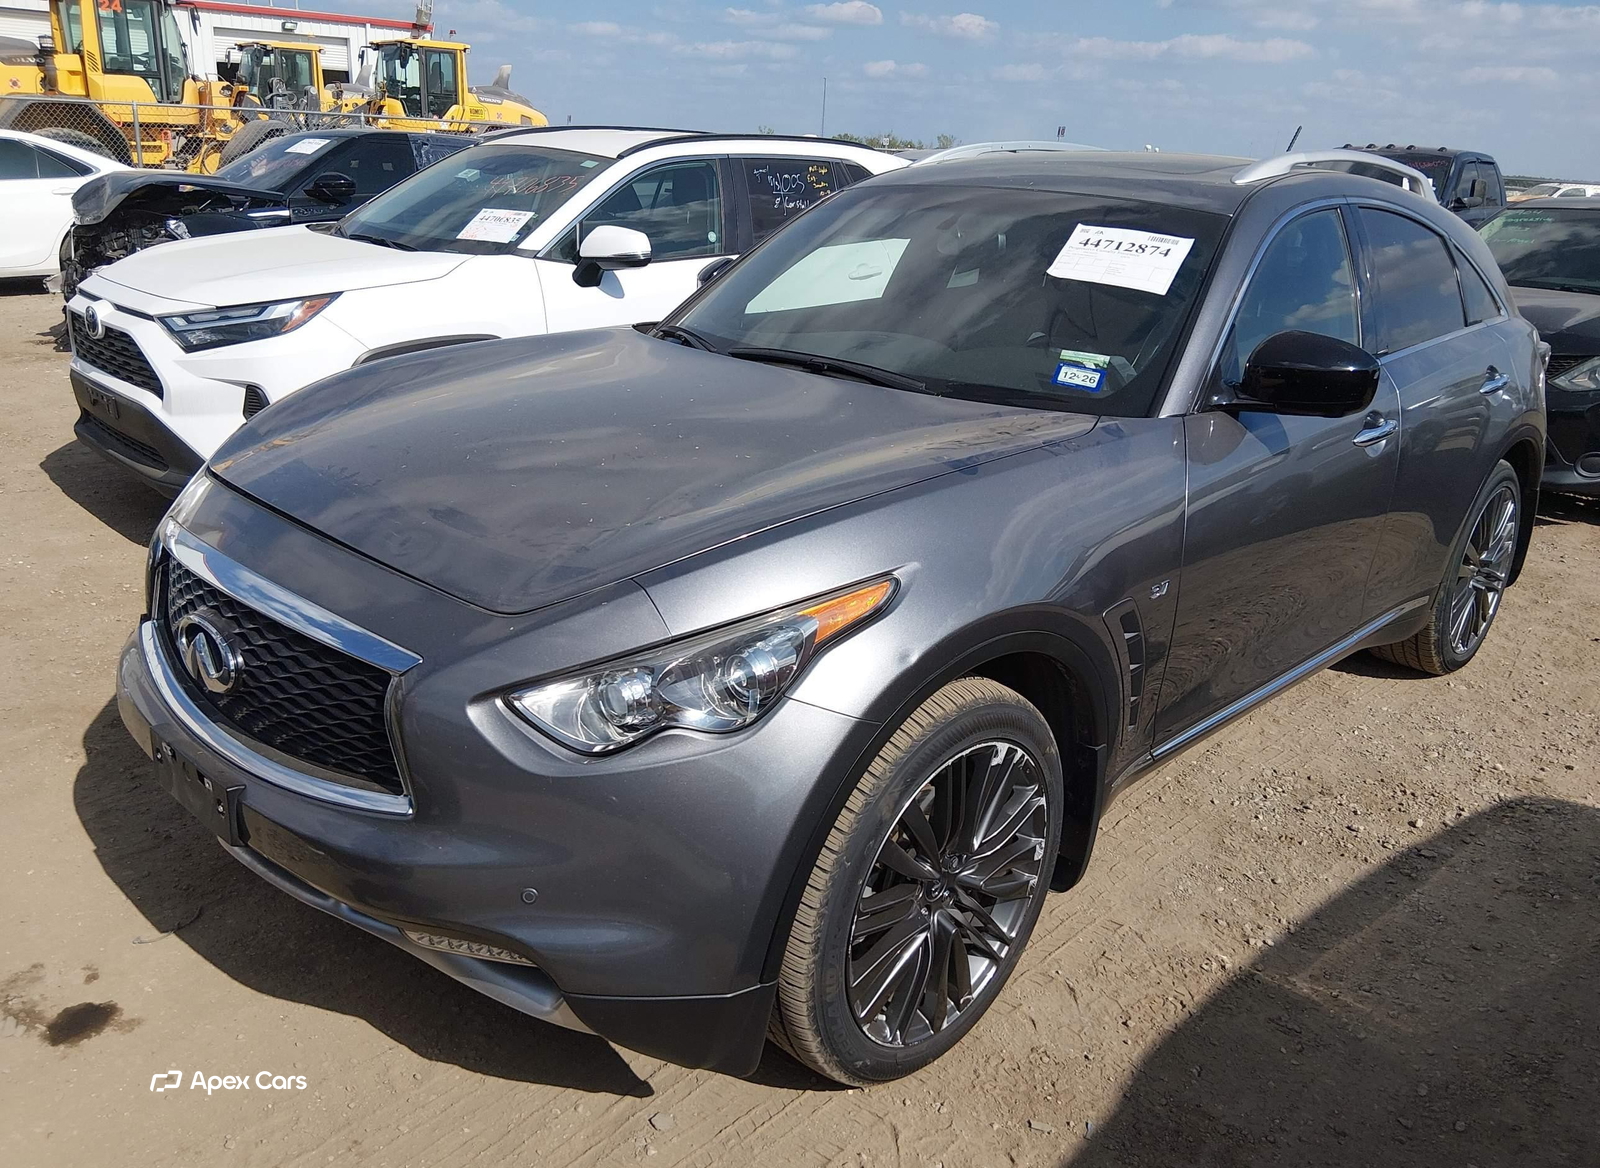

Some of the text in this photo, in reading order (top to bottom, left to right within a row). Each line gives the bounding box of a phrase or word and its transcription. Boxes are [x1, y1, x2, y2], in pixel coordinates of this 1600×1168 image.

[101, 0, 122, 12] 24
[1078, 237, 1172, 258] 44712874
[1062, 371, 1077, 381] 12
[1081, 374, 1097, 384] 26
